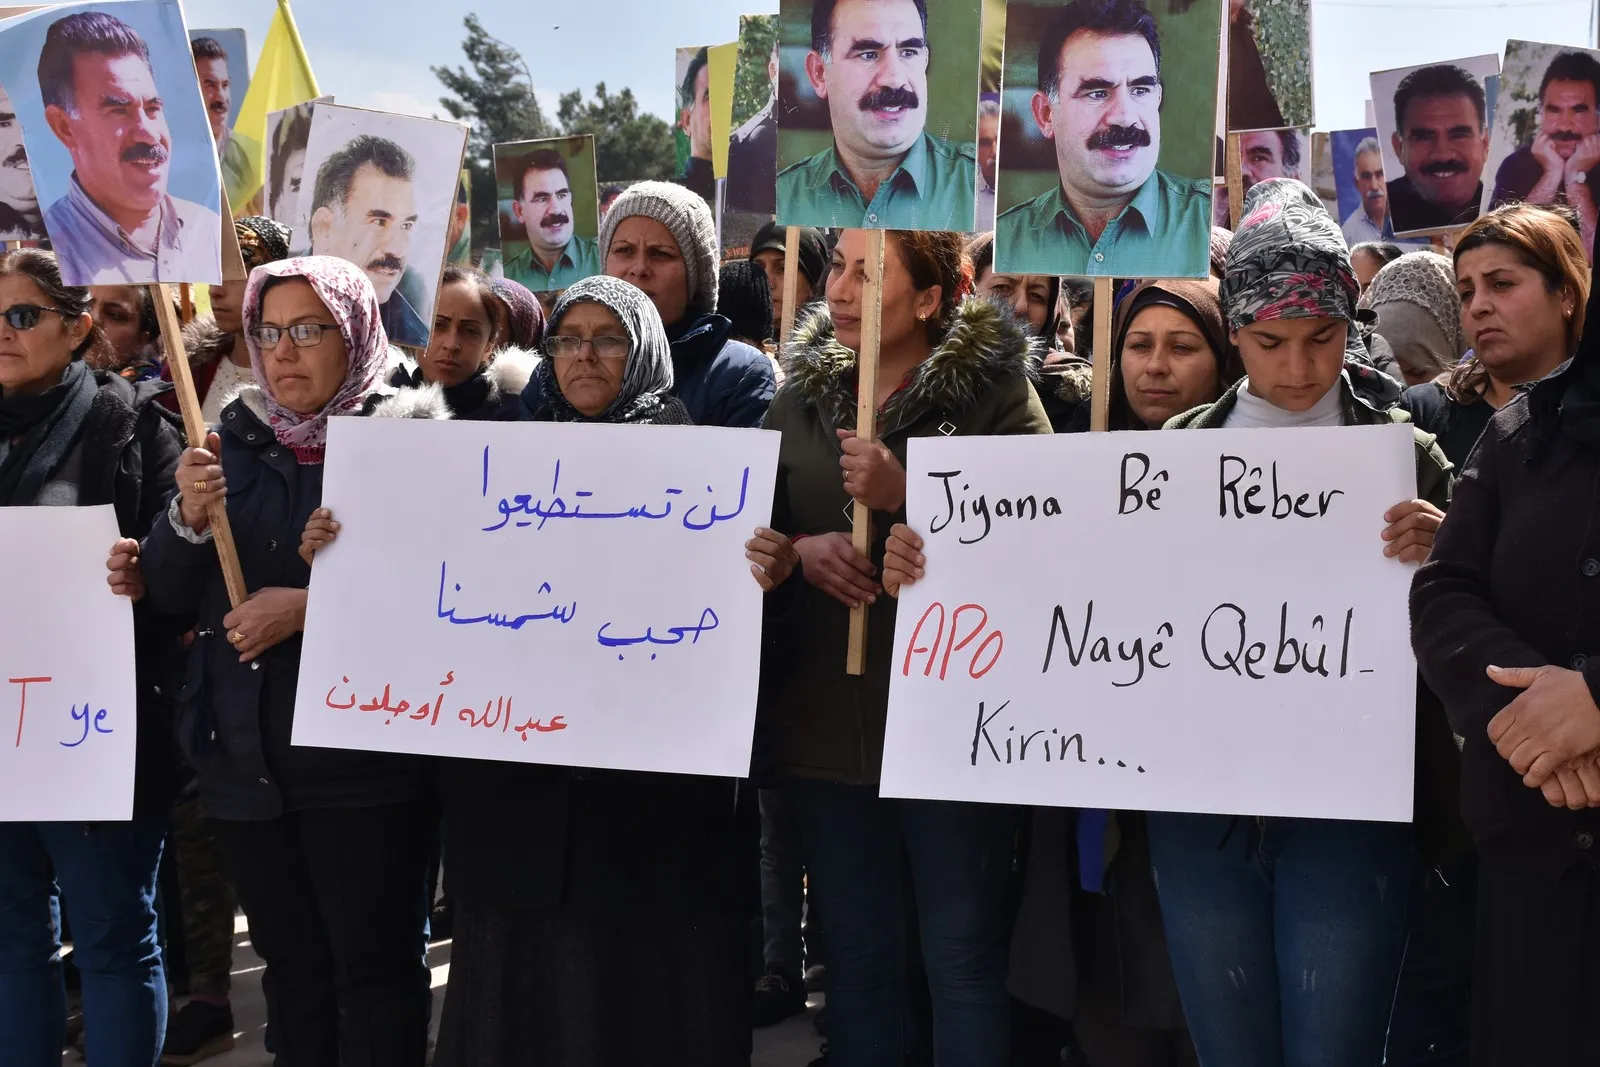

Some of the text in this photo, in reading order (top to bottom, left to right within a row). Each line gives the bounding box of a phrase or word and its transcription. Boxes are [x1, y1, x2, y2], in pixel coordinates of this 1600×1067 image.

[482, 445, 750, 532] لن تستطيعوا
[927, 453, 1345, 545] Jiyana Bê Rêber
[437, 560, 719, 661] حجب شمسنا
[1042, 600, 1174, 688] Nayê
[9, 676, 114, 748] T ye
